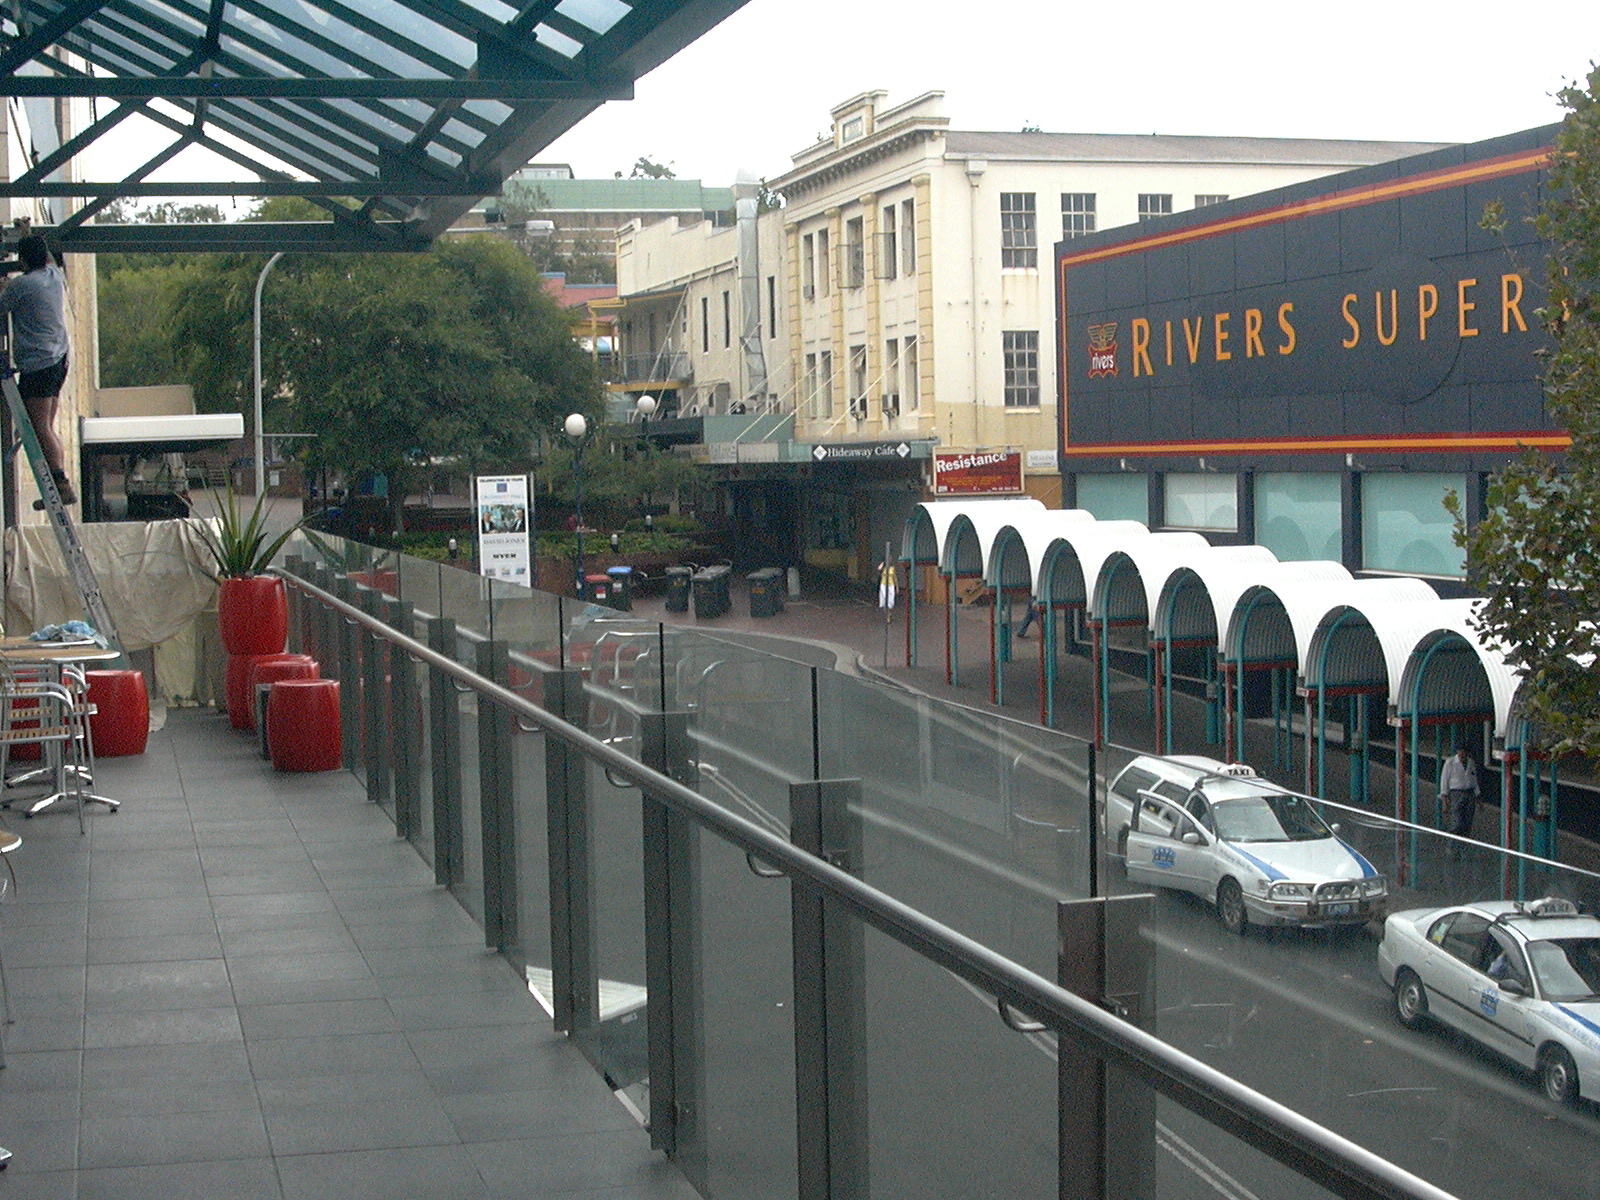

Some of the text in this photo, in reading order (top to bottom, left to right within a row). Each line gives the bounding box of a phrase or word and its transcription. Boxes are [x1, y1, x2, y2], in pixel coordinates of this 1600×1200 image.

[1131, 266, 1571, 378] RIVERS SUPER
[1091, 352, 1115, 370] rivers
[827, 447, 873, 458] Hideaway
[936, 453, 1008, 473] Resistance
[1227, 768, 1250, 776] TAXI
[1542, 902, 1569, 913] TAXI
